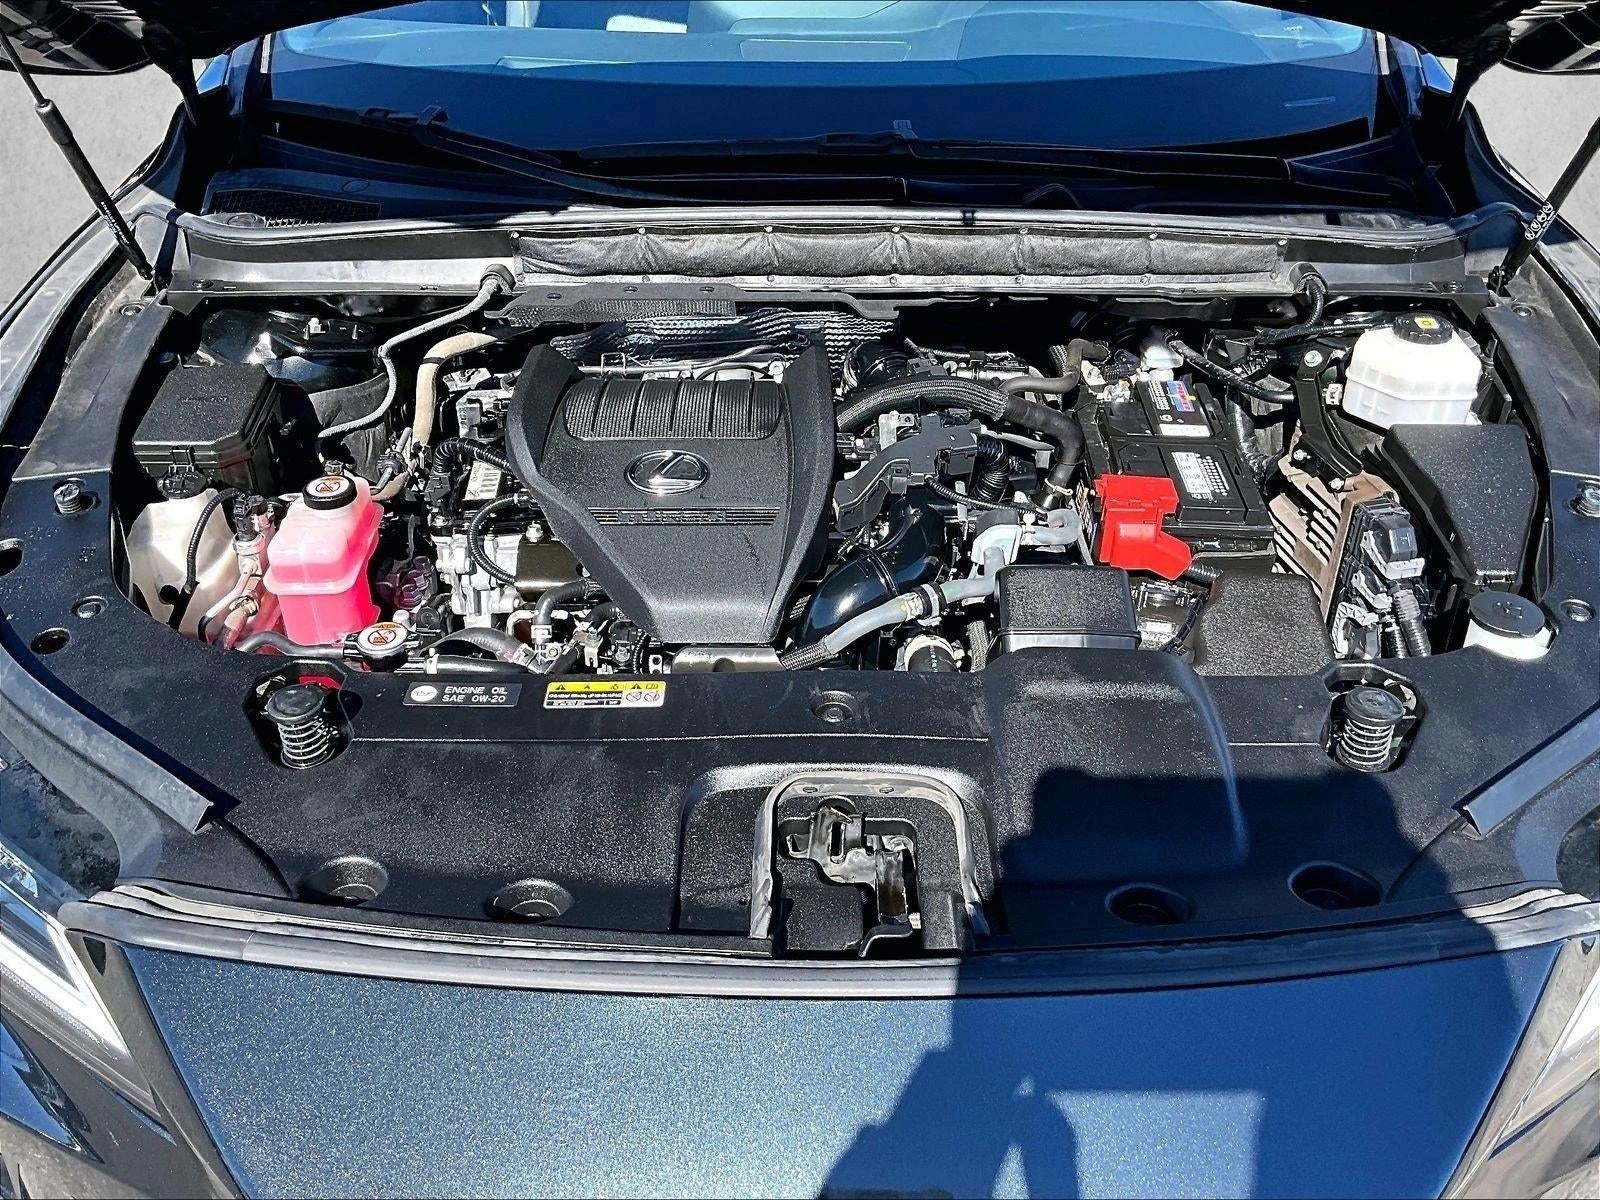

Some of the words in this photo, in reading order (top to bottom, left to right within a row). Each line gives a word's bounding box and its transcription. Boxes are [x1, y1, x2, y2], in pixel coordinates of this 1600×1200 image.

[444, 686, 486, 694] ENGINE
[491, 686, 508, 695] OIL
[441, 694, 466, 702] SAE
[471, 695, 506, 703] 0W-20
